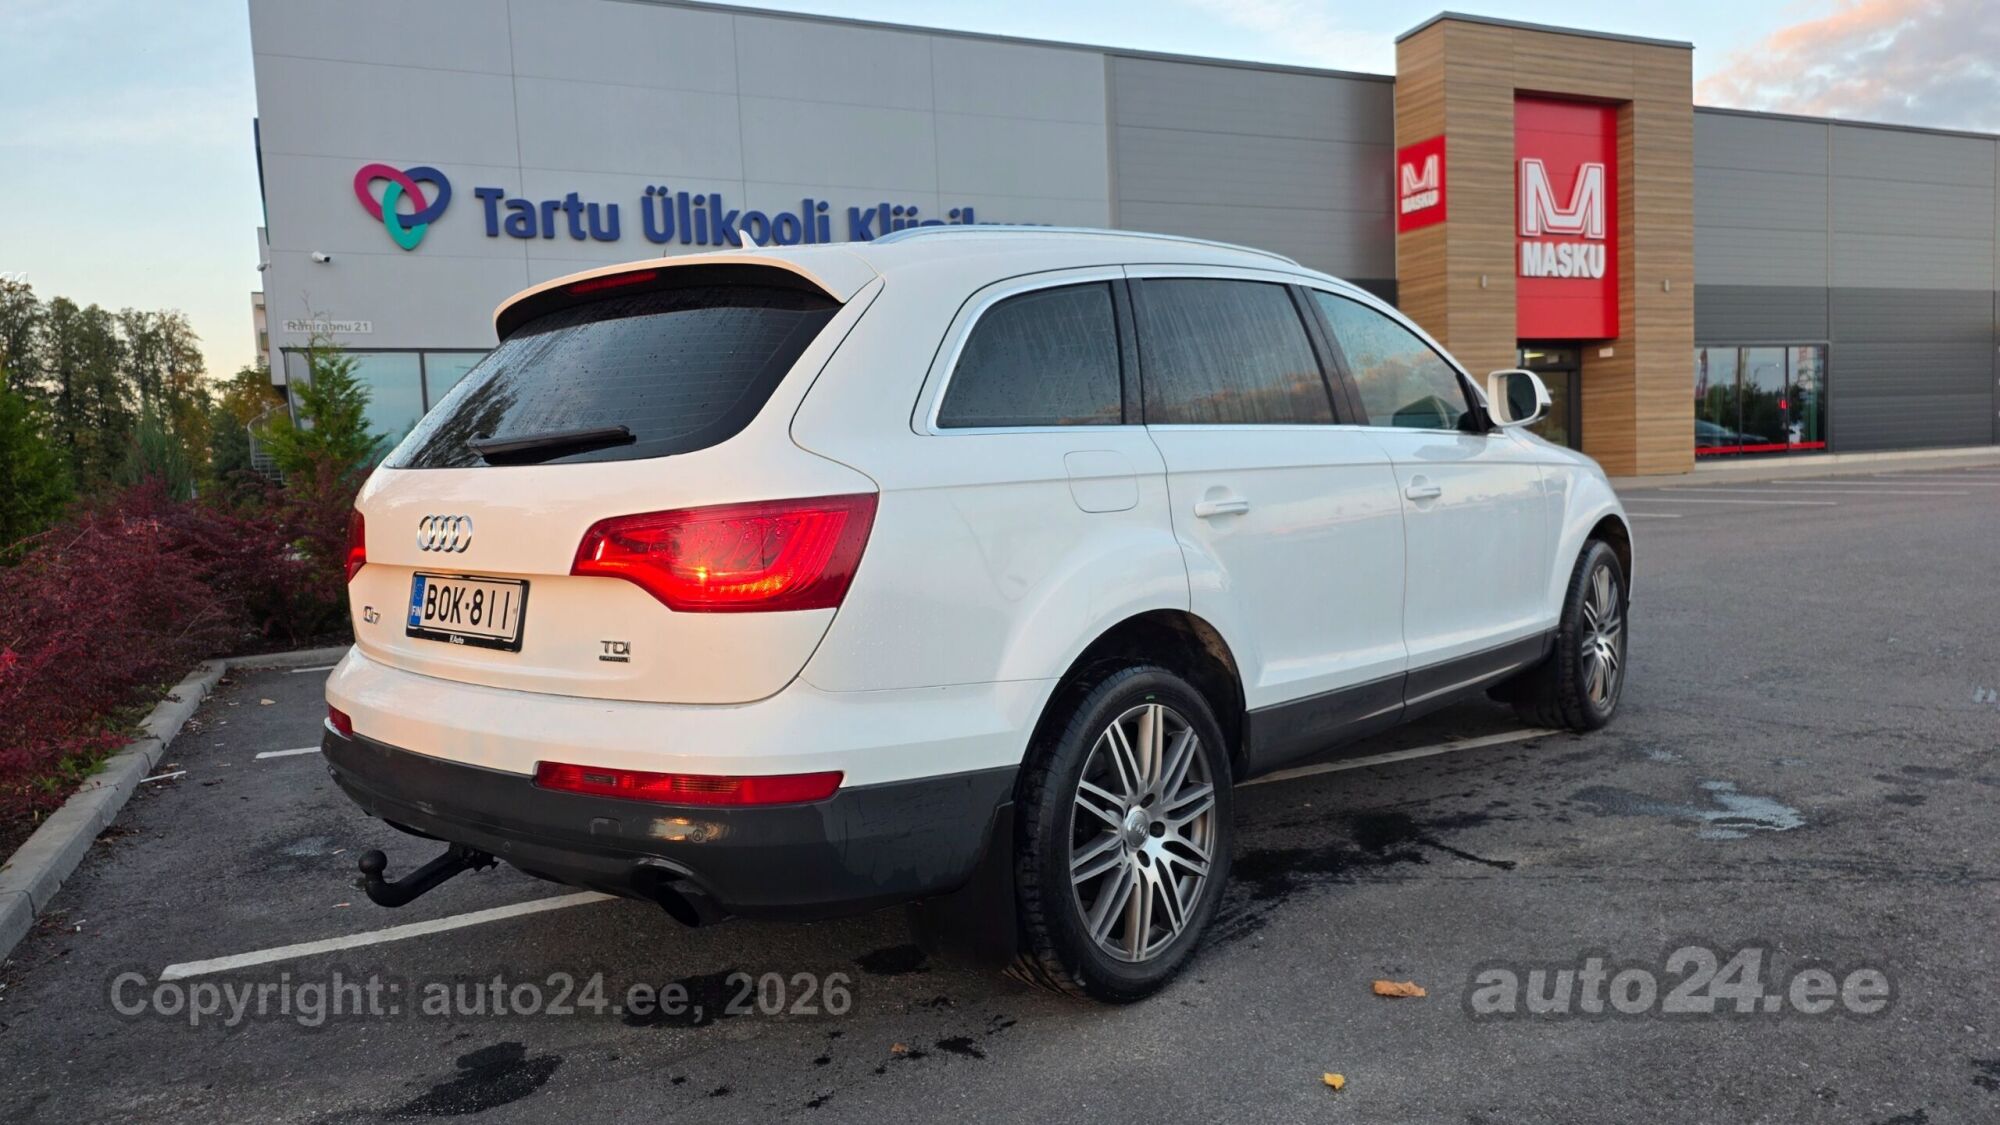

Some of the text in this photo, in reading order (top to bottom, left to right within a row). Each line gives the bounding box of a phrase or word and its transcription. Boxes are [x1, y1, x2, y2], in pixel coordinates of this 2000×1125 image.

[475, 186, 620, 241] Tartu
[641, 185, 830, 247] Ülikooli
[1401, 189, 1439, 214] MASKU
[1522, 241, 1605, 279] MASKU
[354, 321, 369, 332] 21
[424, 583, 511, 630] BOK-811
[600, 640, 631, 655] TDI
